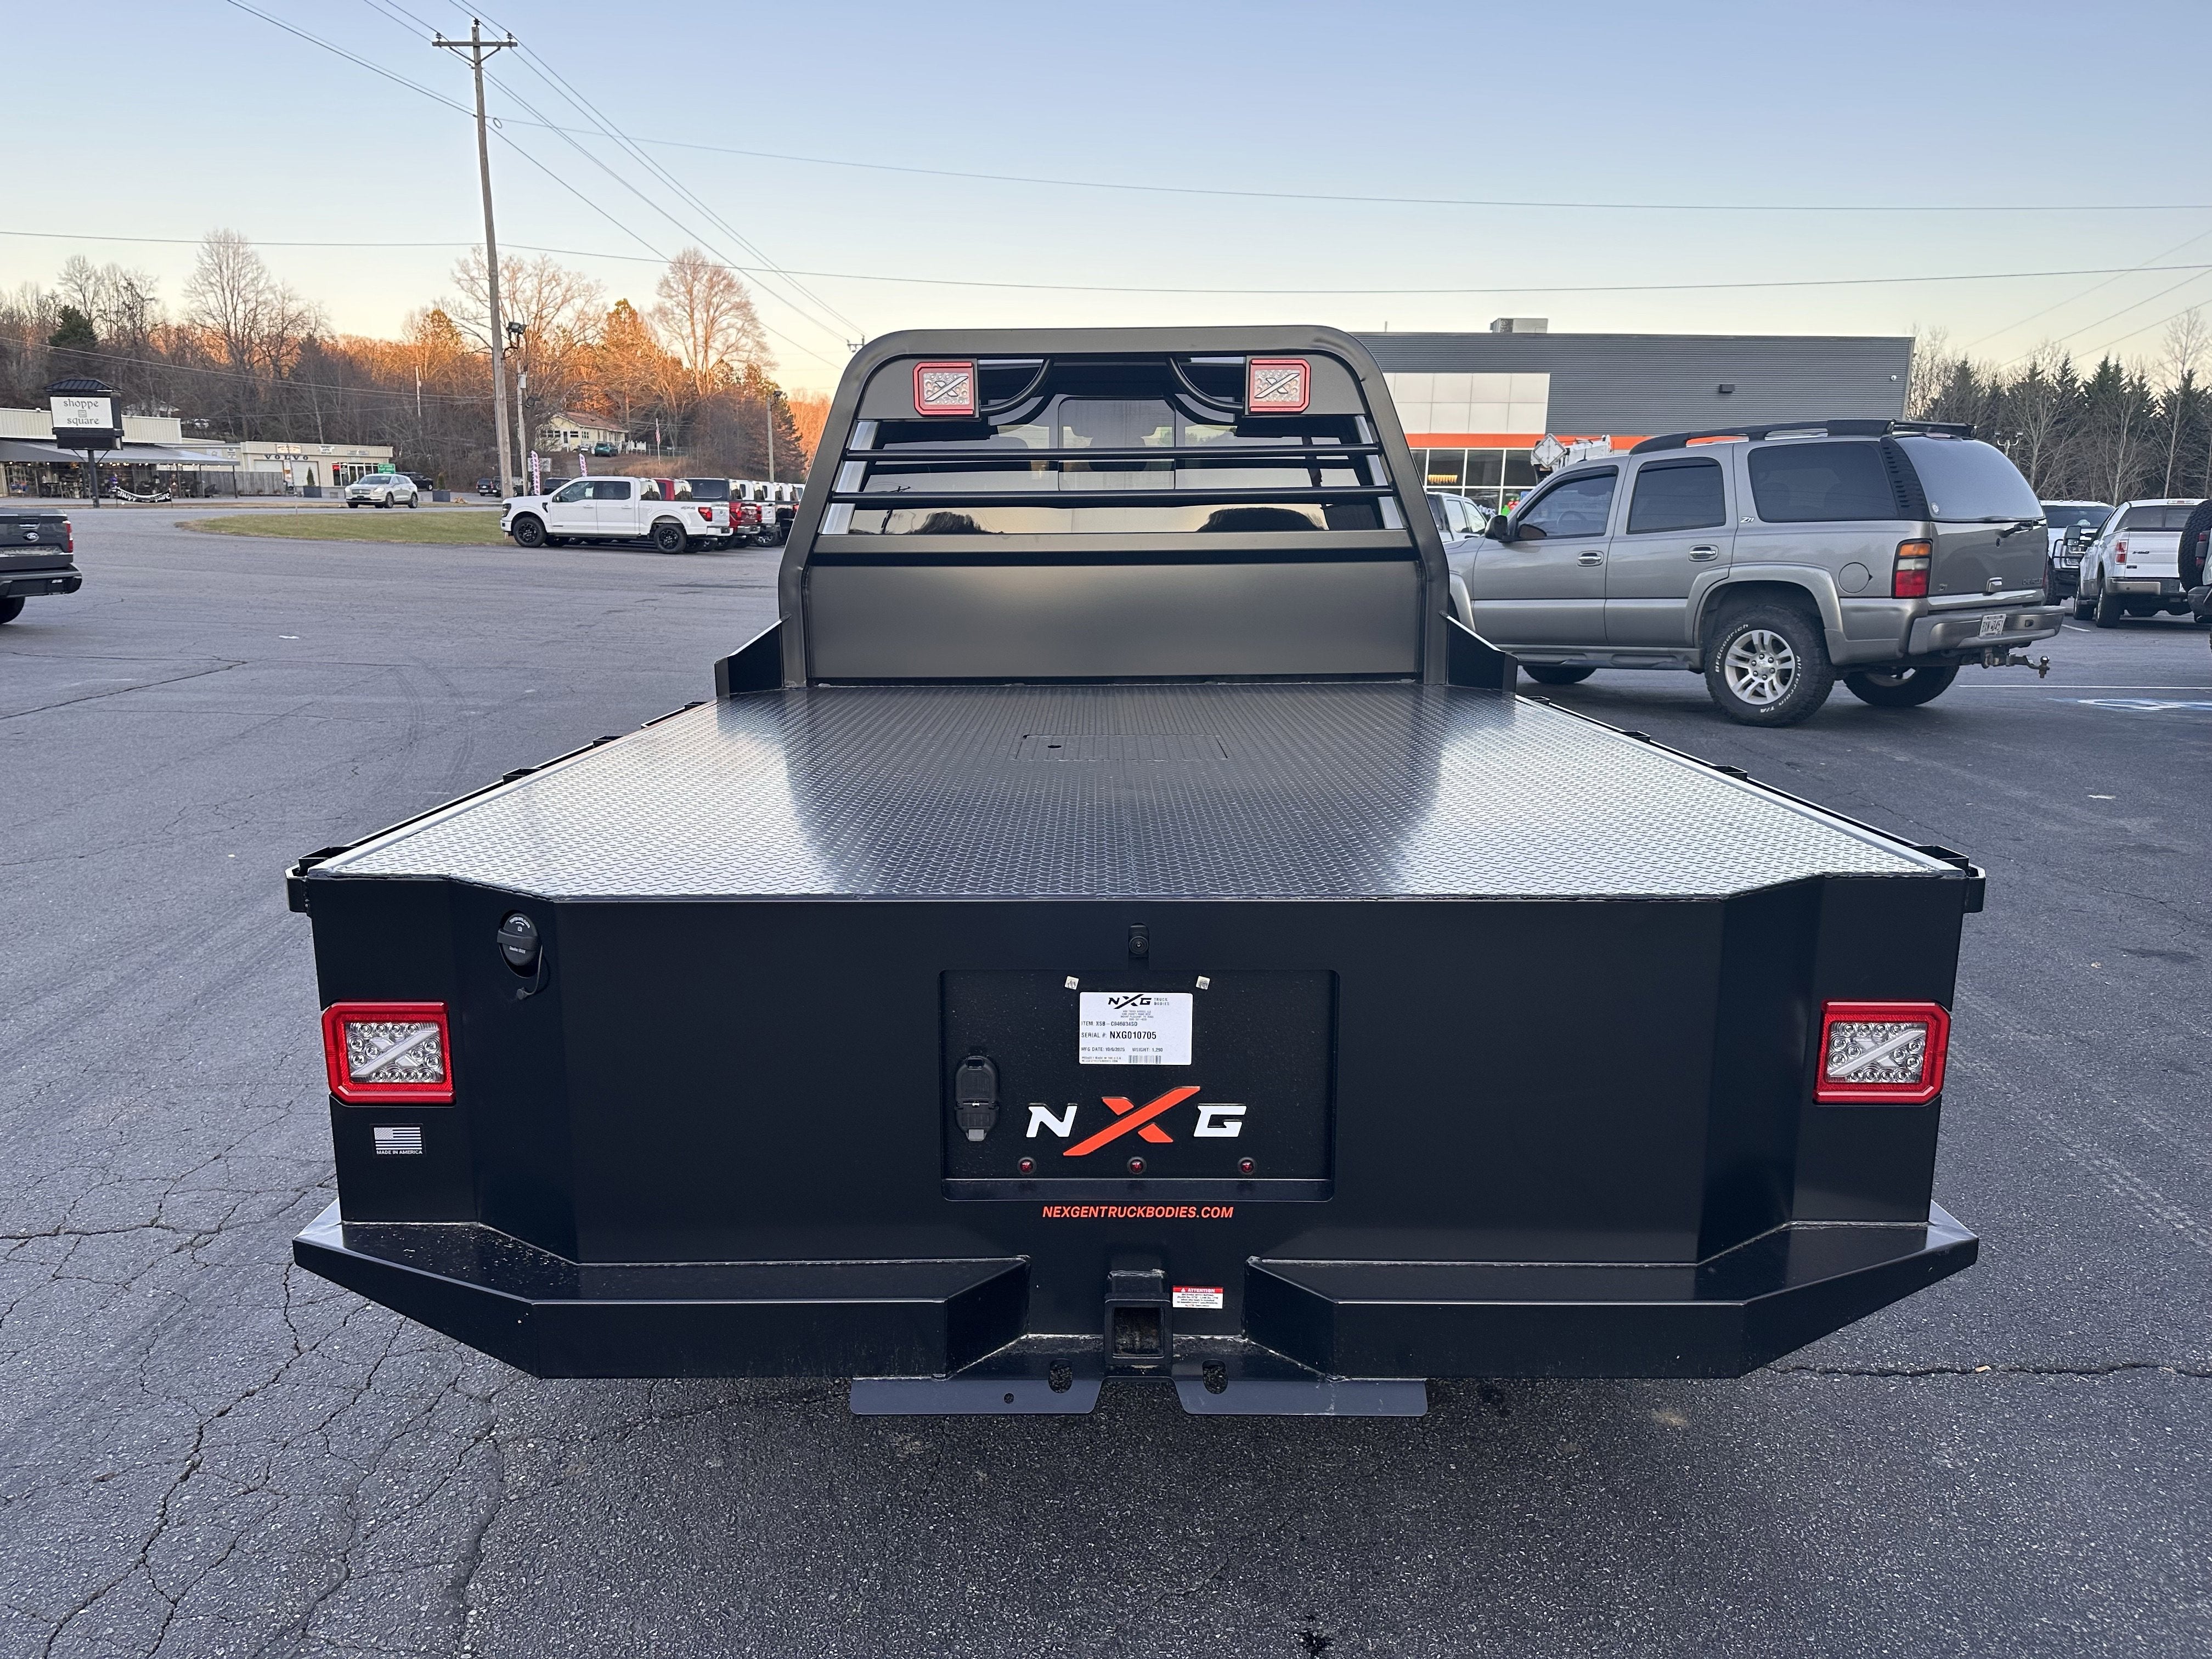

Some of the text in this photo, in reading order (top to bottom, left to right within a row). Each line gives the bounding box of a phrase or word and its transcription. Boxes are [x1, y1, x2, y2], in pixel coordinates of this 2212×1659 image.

[64, 399, 99, 409] shoppe
[67, 417, 100, 426] square
[1108, 994, 1152, 1009] NXG
[1109, 1031, 1157, 1039] NXG010705
[1025, 1086, 1248, 1157] NXG
[1042, 1206, 1234, 1218] NEXGENTRUCKBODIES.COM
